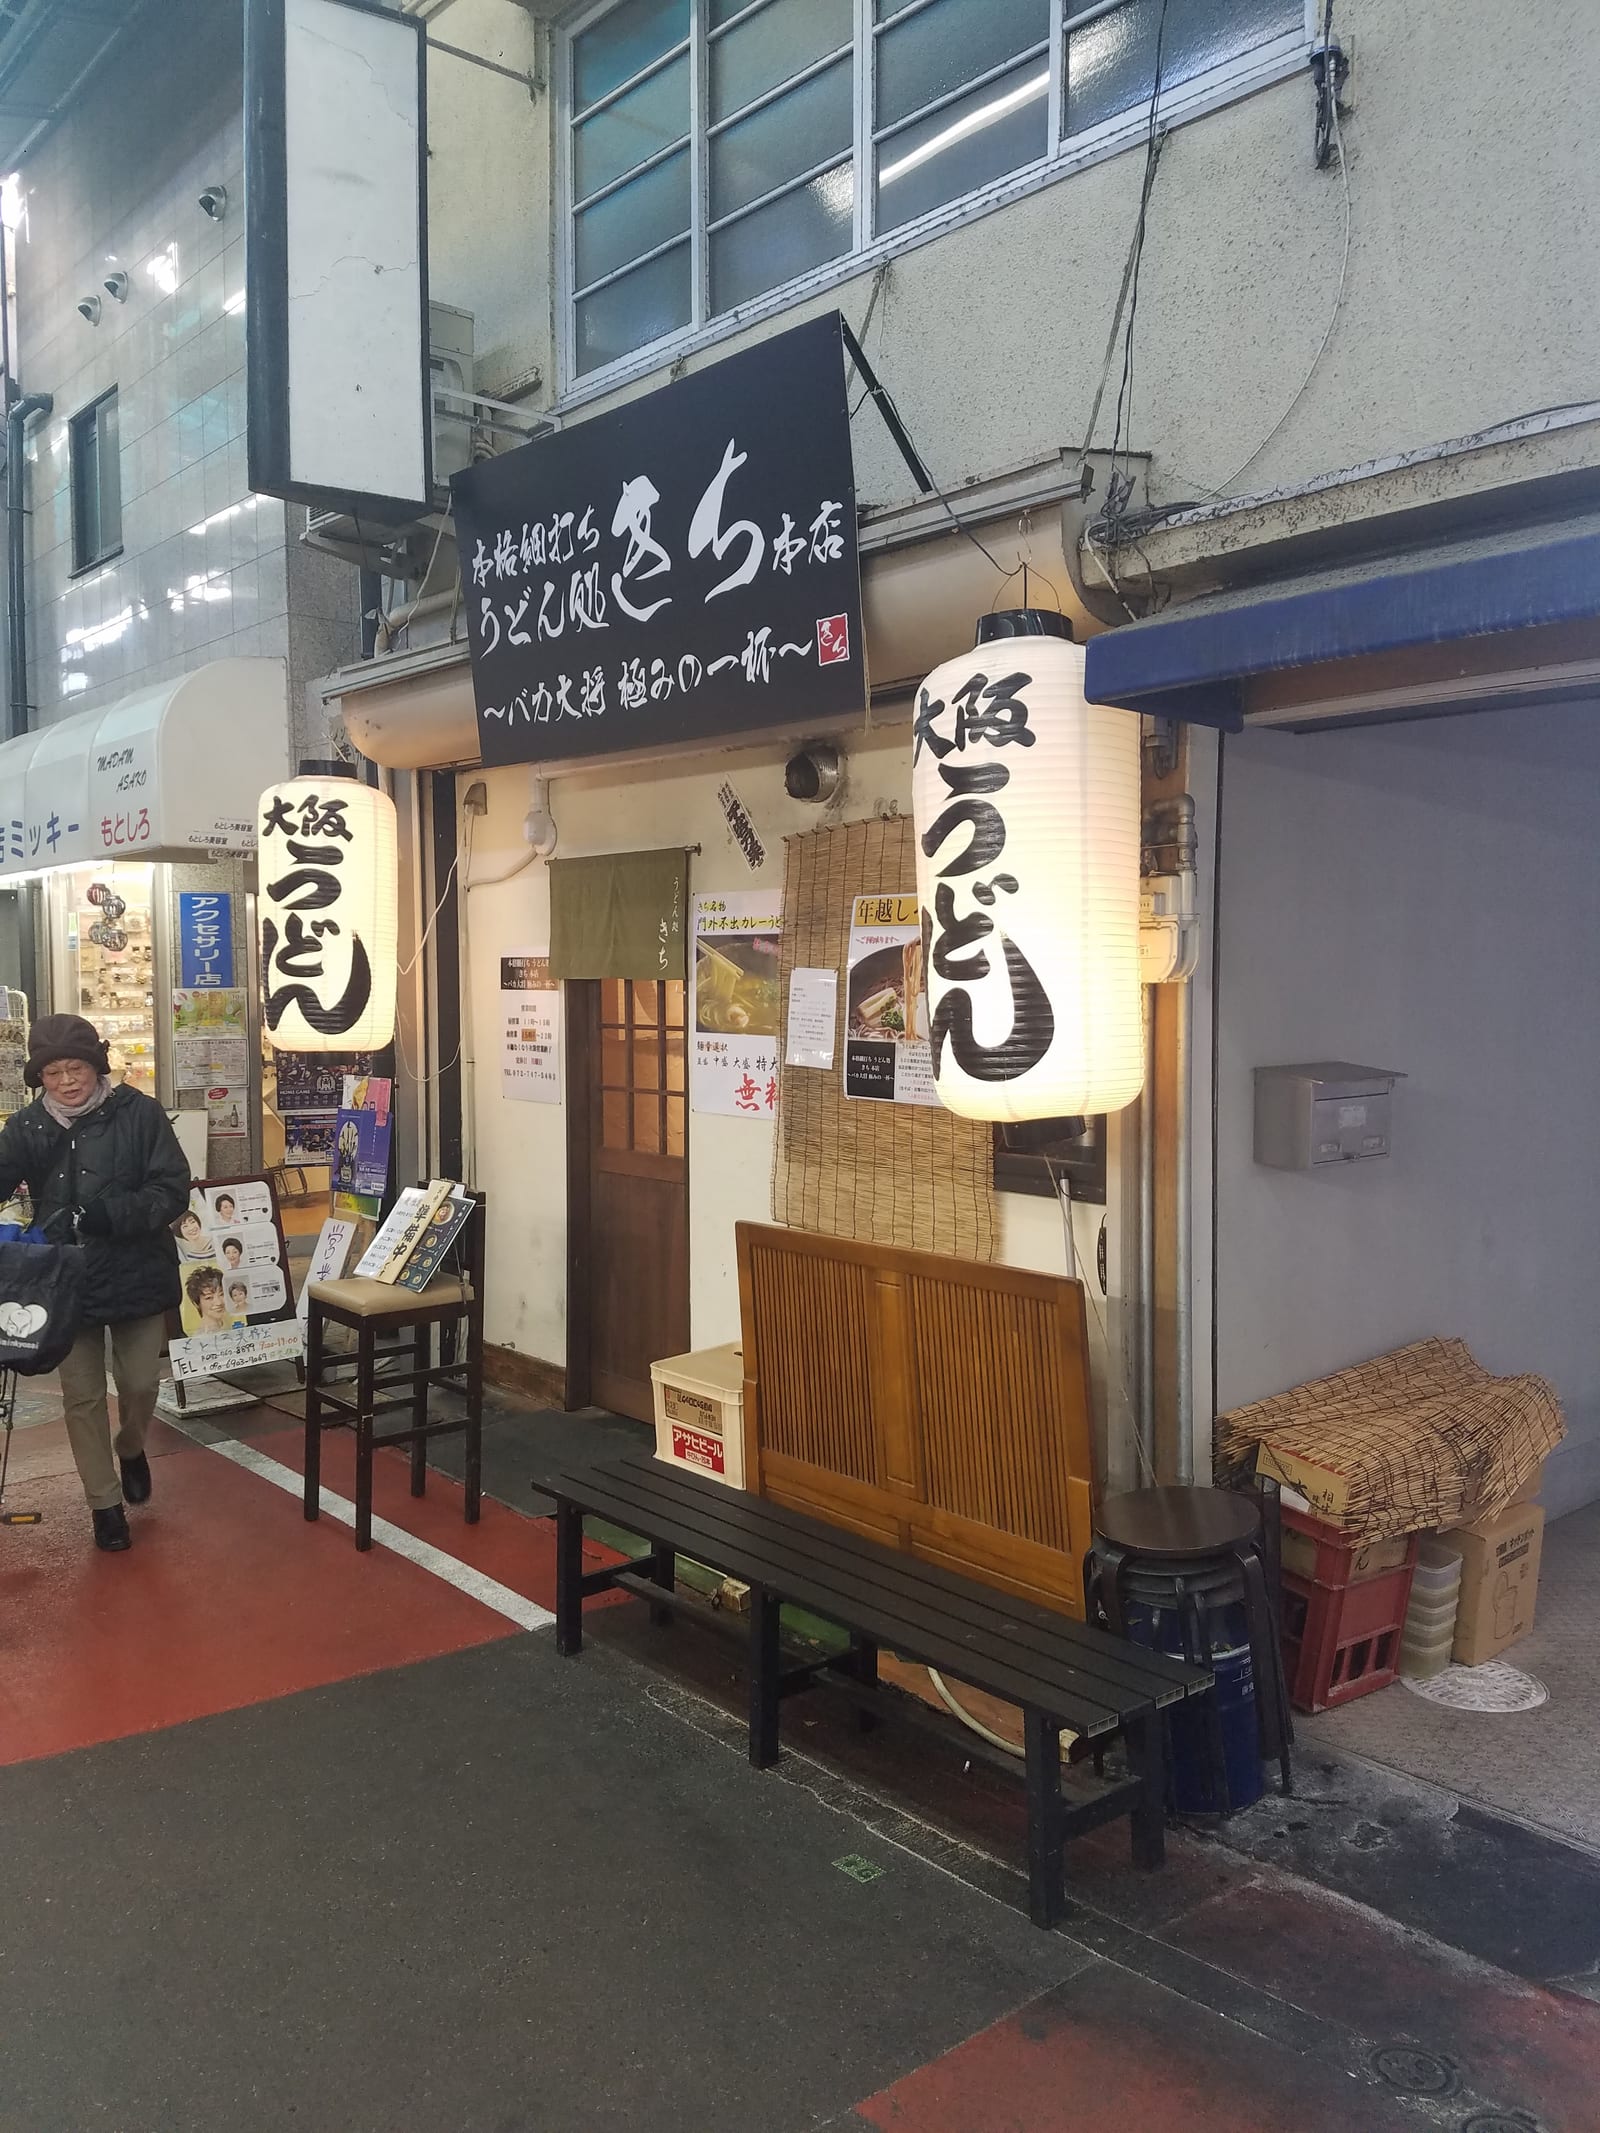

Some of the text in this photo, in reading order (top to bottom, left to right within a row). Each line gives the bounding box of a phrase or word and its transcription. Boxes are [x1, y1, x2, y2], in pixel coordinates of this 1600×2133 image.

[772, 499, 845, 576] 本店
[479, 562, 610, 660] うどん処
[914, 671, 1038, 770] 大阪
[97, 748, 134, 772] MADAM
[116, 769, 147, 793] ASAKO
[101, 808, 151, 847] もとしろ
[262, 794, 354, 842] 大阪
[857, 898, 919, 924] 年越し
[191, 896, 223, 986] アクセサリー店
[262, 838, 372, 1035] うどん
[173, 1356, 199, 1378] TEL
[673, 1428, 723, 1459] アサヒビール
